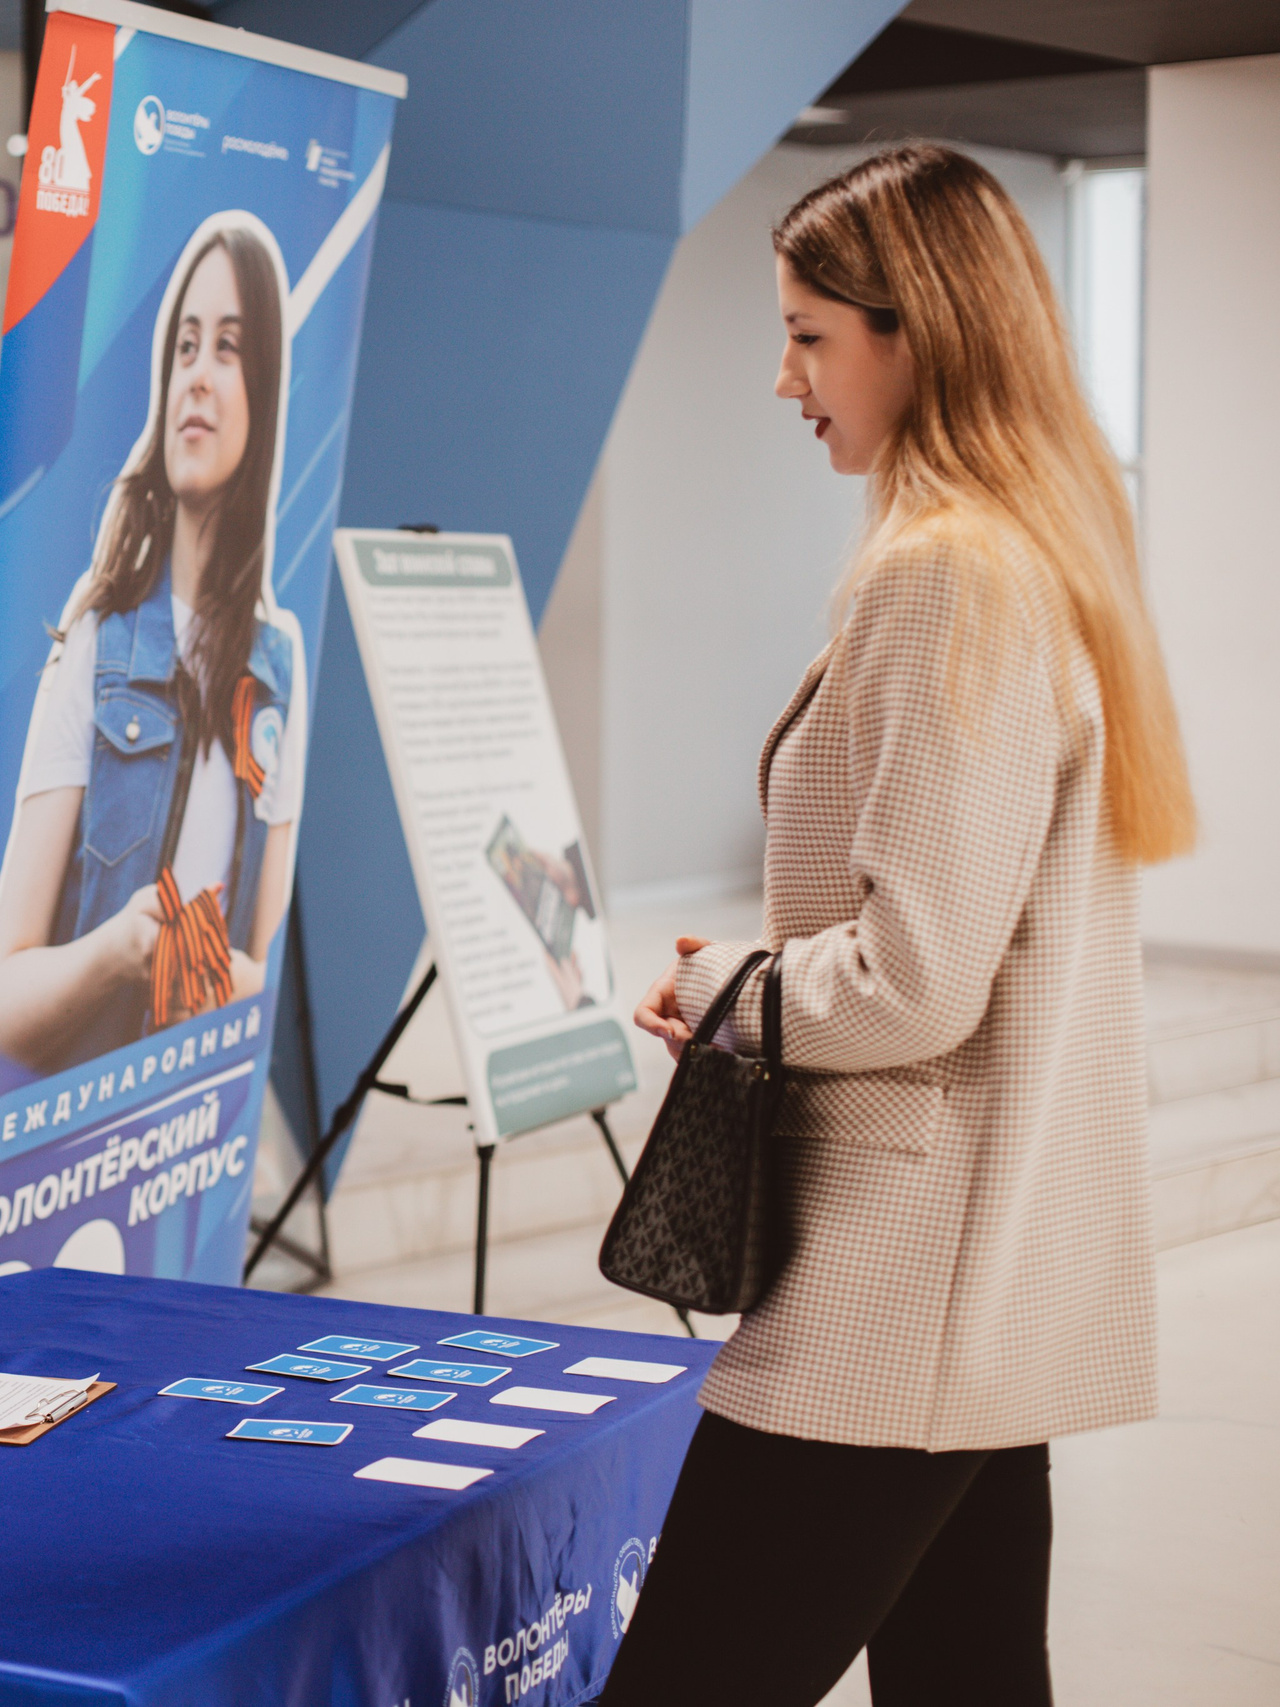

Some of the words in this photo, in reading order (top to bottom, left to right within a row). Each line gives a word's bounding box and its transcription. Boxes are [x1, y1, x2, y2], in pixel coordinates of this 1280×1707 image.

[127, 1134, 249, 1227] КОРПУС
[483, 1582, 593, 1676] ВОЛОНТЁРЫ
[504, 1630, 570, 1705] ПОБЕДЫ
